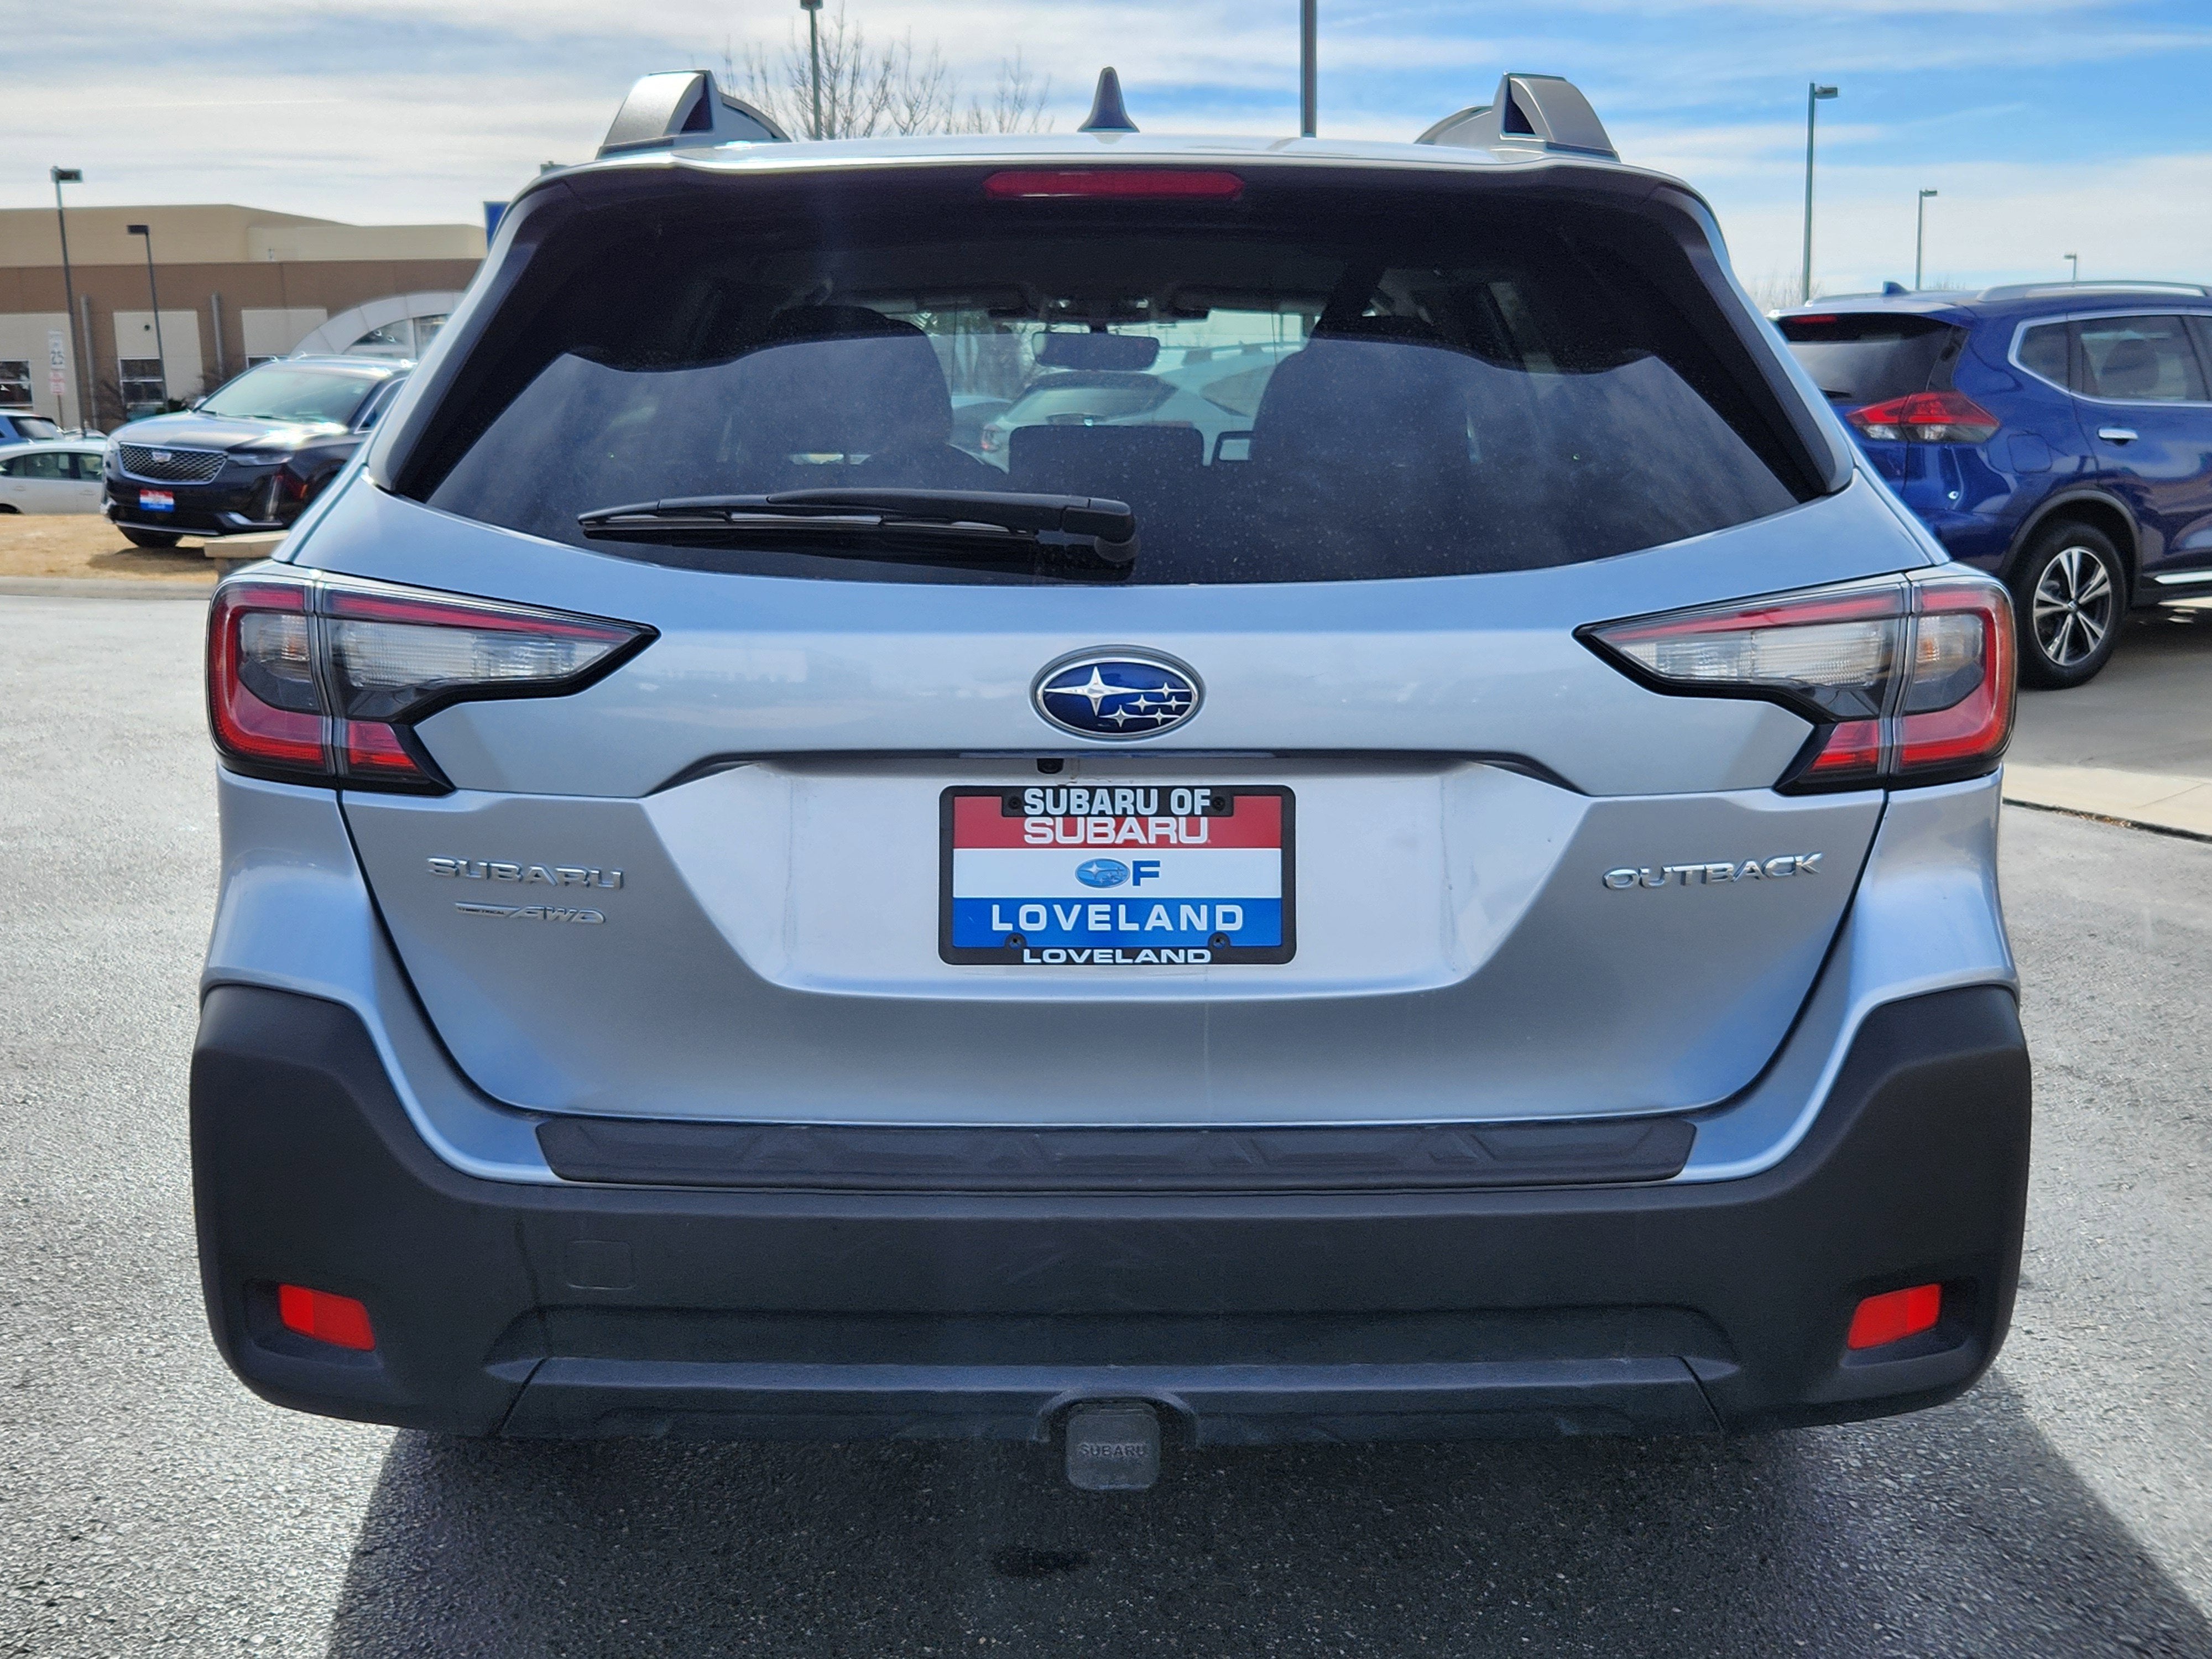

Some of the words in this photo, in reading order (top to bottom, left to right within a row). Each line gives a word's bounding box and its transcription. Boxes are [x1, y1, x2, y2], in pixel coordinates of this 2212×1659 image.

[1024, 789, 1157, 815] SUBARU
[1171, 789, 1211, 815] OF
[1024, 816, 1208, 844] SUBARU
[426, 855, 625, 890] SUBARU
[1603, 851, 1823, 890] OUTBACK
[509, 905, 606, 924] AWD
[992, 904, 1243, 931] LOVELAND
[1023, 949, 1211, 963] LOVELAND
[1079, 1442, 1145, 1457] SUBARU
